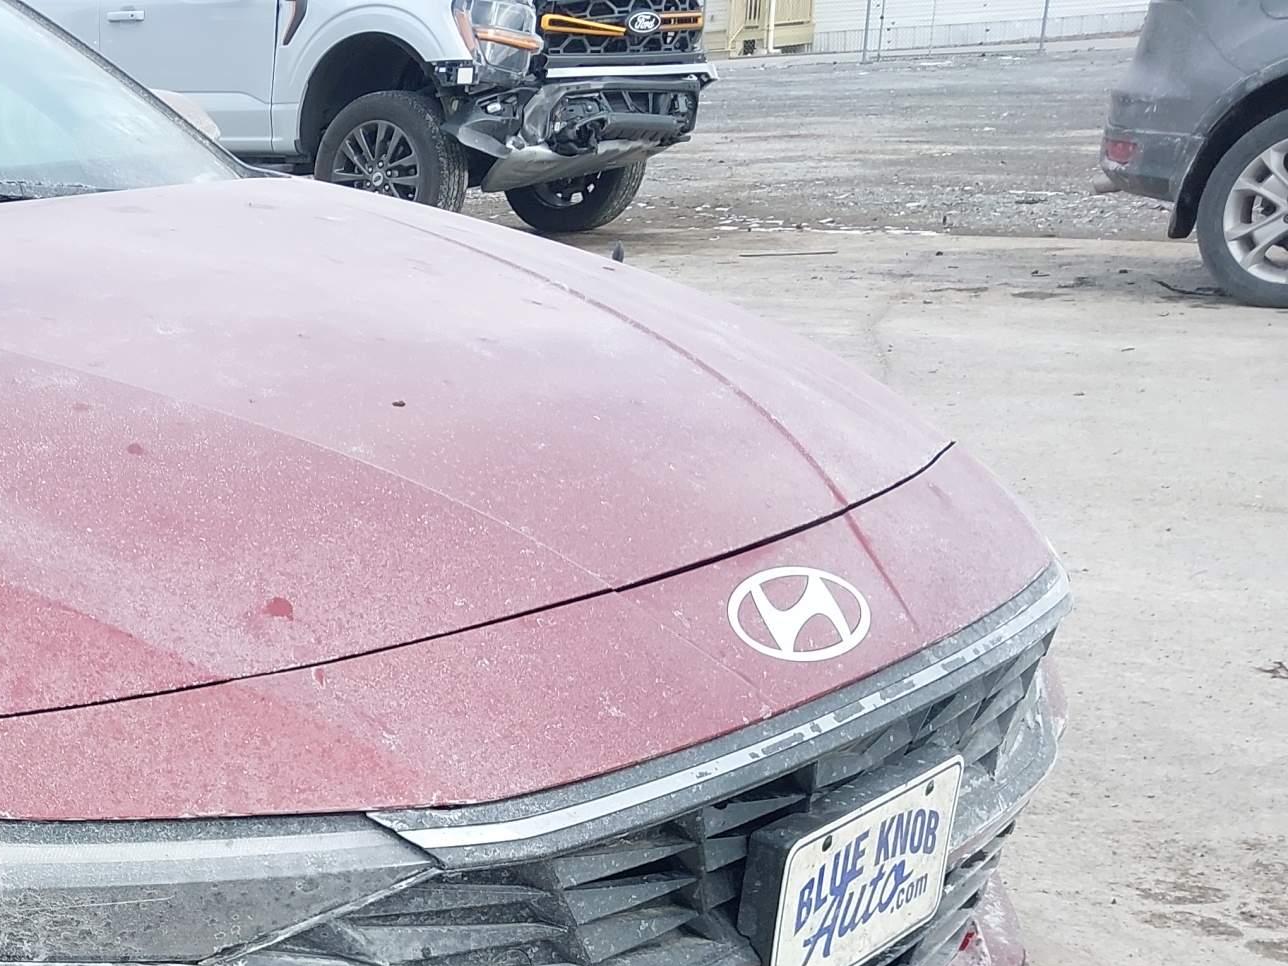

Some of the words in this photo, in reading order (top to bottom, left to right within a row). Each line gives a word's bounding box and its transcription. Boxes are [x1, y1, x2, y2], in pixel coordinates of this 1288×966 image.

[634, 14, 656, 30] Ford
[794, 829, 871, 937] BLUE
[874, 808, 940, 868] KNOB
